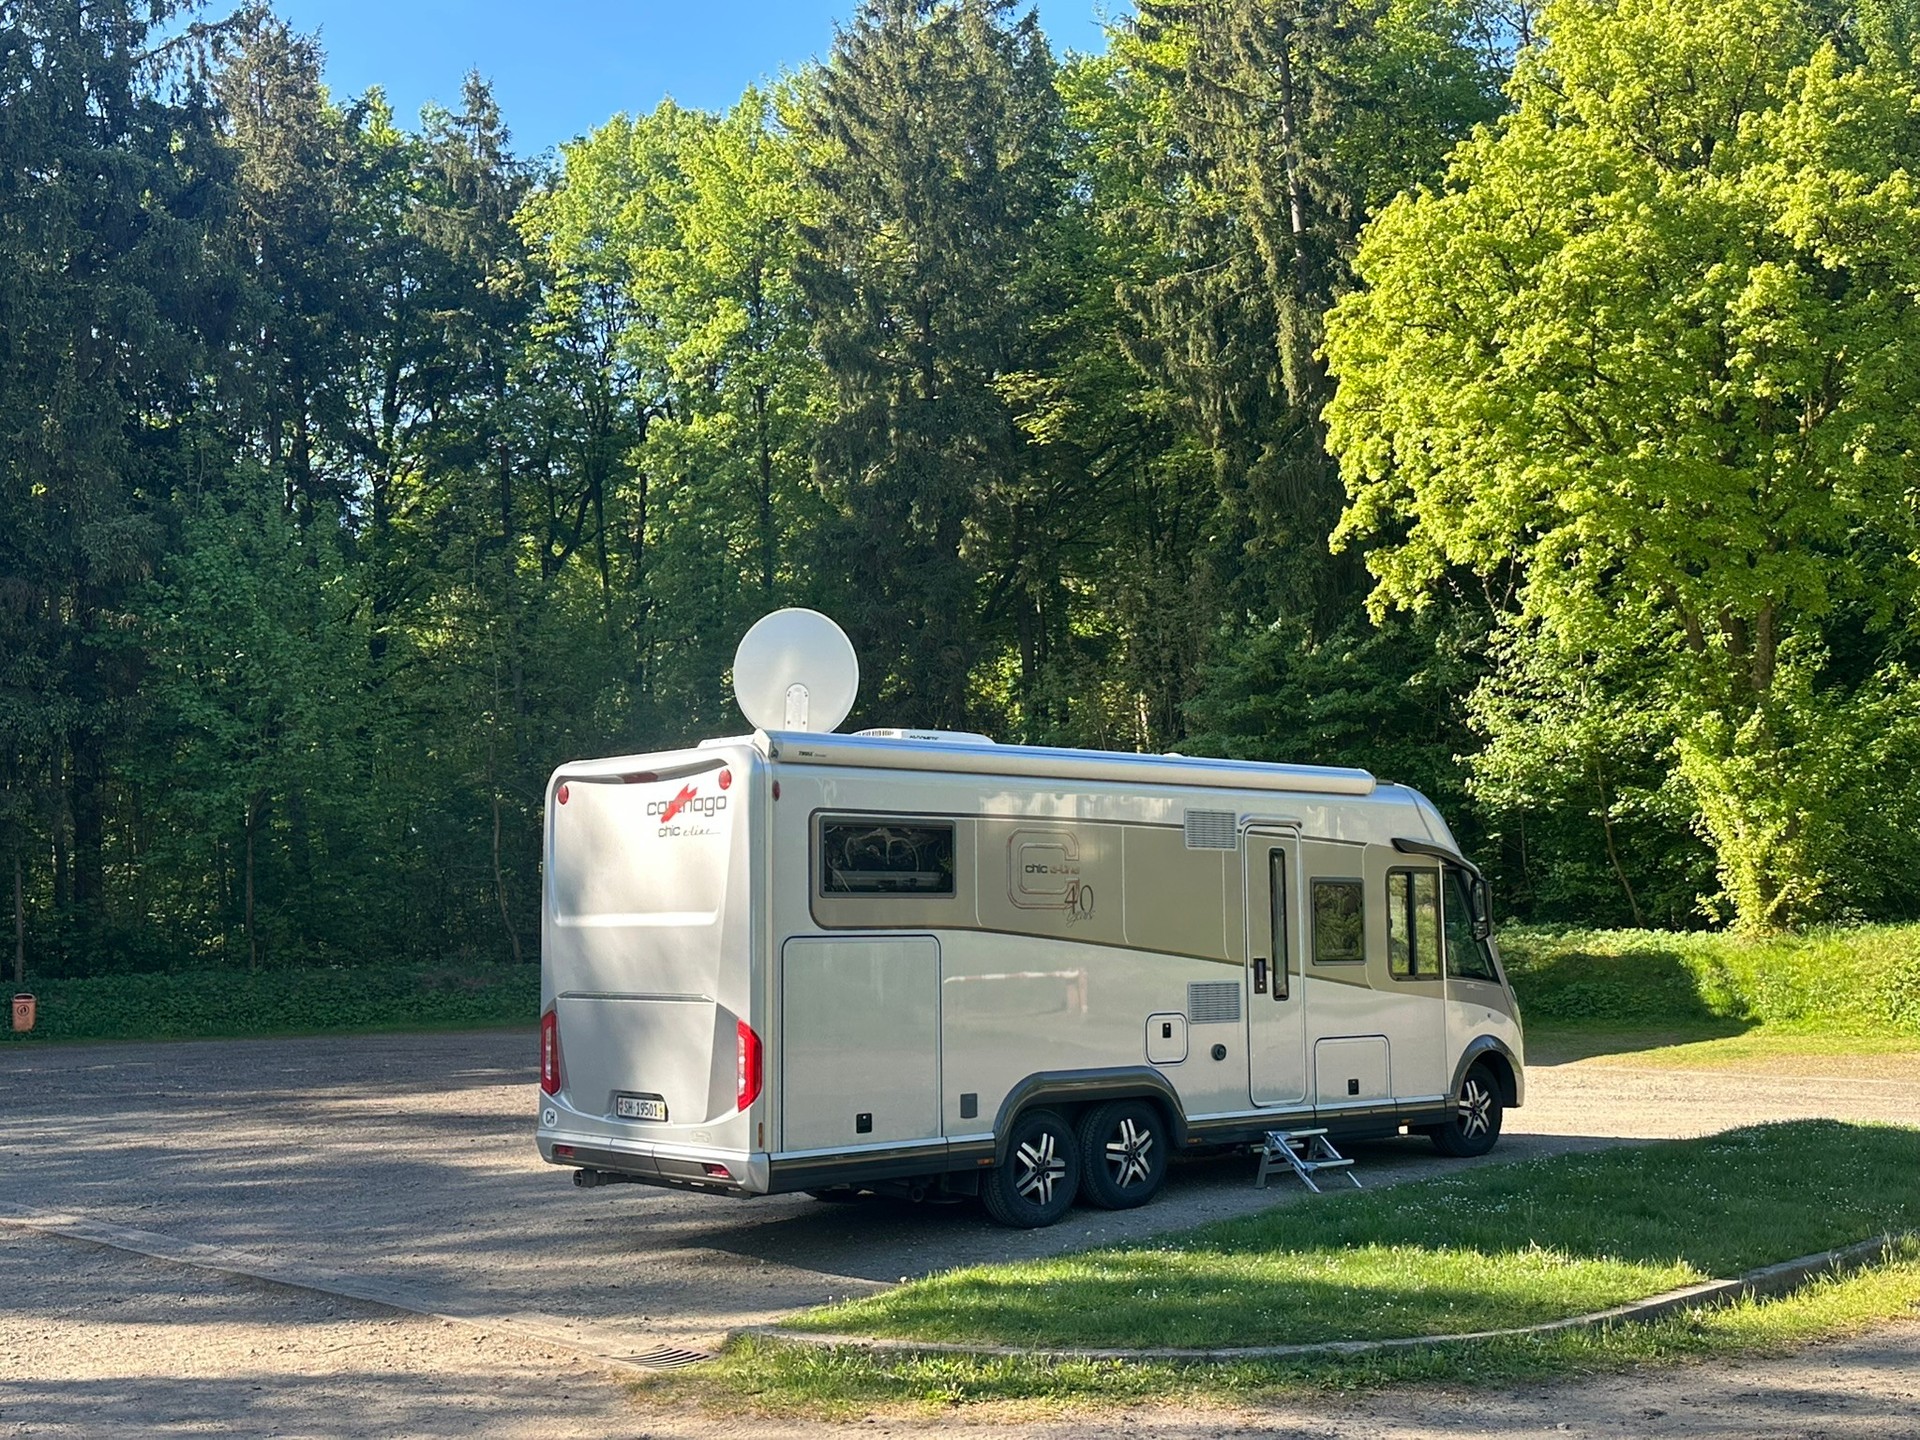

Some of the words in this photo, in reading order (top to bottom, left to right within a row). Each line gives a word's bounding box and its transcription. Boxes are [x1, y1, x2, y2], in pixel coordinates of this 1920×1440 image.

[647, 794, 727, 818] carhago
[658, 825, 681, 838] chic
[1025, 863, 1048, 874] chic
[1064, 884, 1094, 914] 40
[636, 1101, 658, 1117] 19501
[545, 1110, 556, 1125] CH
